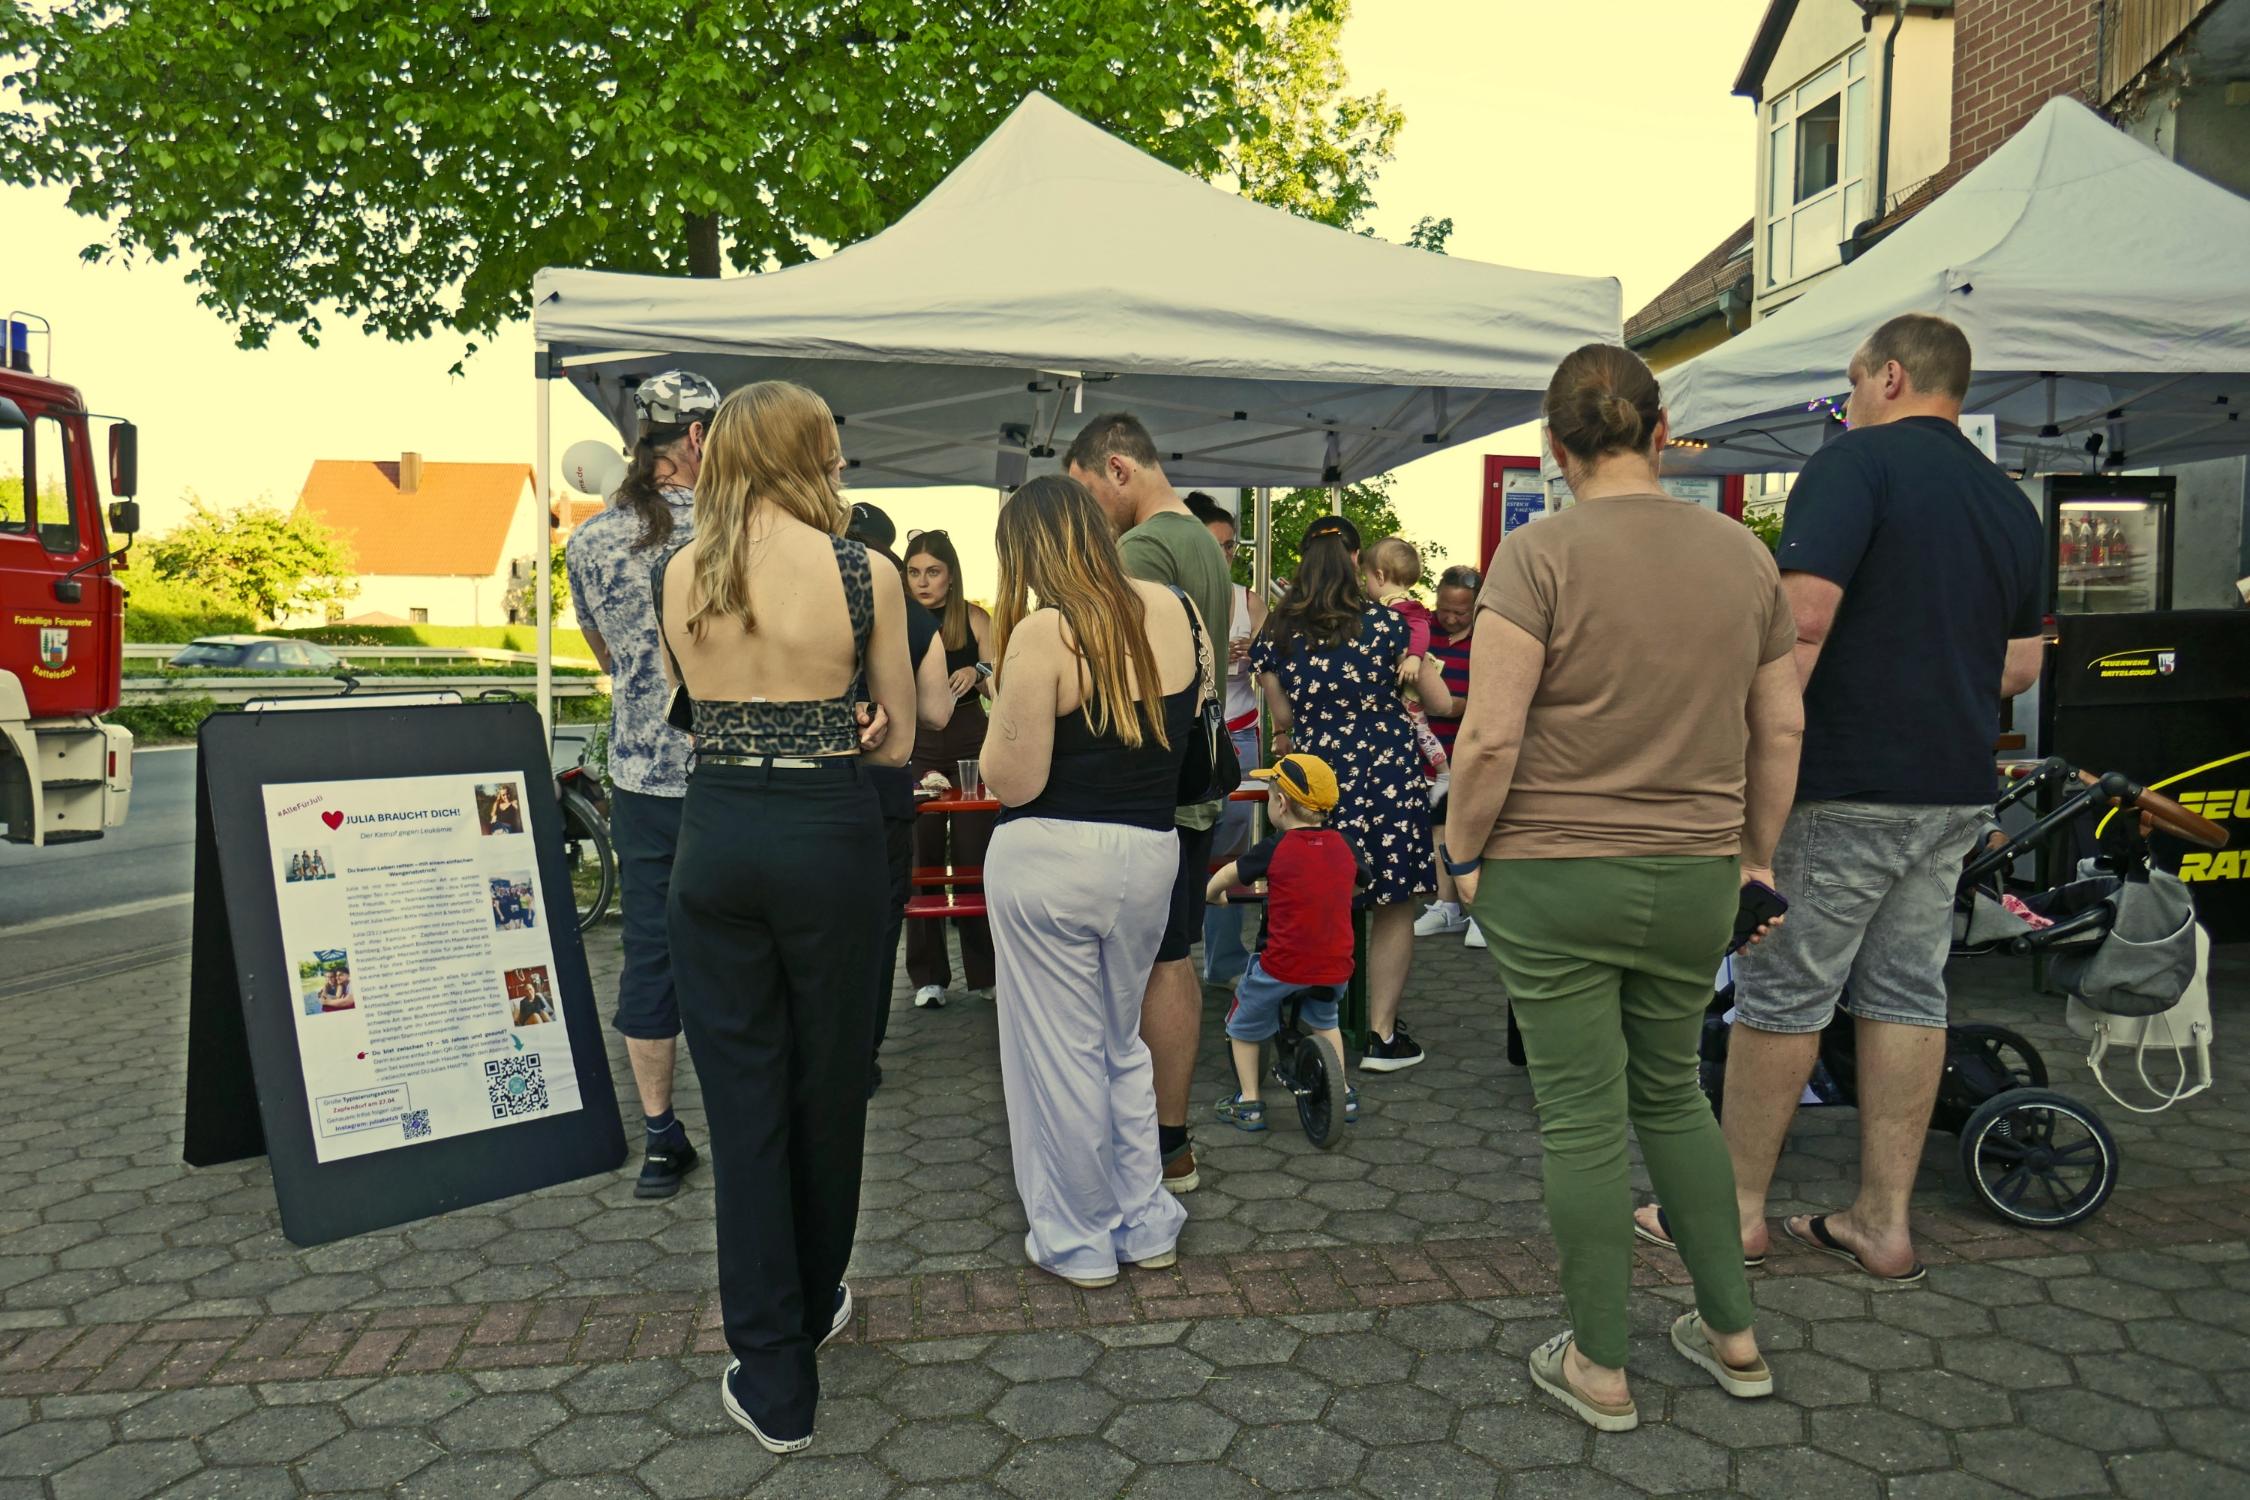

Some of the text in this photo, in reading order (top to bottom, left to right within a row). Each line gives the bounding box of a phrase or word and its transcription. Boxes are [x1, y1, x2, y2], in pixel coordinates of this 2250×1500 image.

[14, 615, 93, 627] Freiwillige Feuerwehr
[2100, 659, 2150, 667] FEUERWEHR
[32, 665, 76, 679] Rattelsdorf
[2101, 669, 2157, 677] RATTELSDORF
[345, 808, 460, 824] JULIA BRAUCHT DICH!
[359, 831, 373, 840] Der
[374, 830, 397, 838] Kampf
[397, 828, 419, 837] gegen
